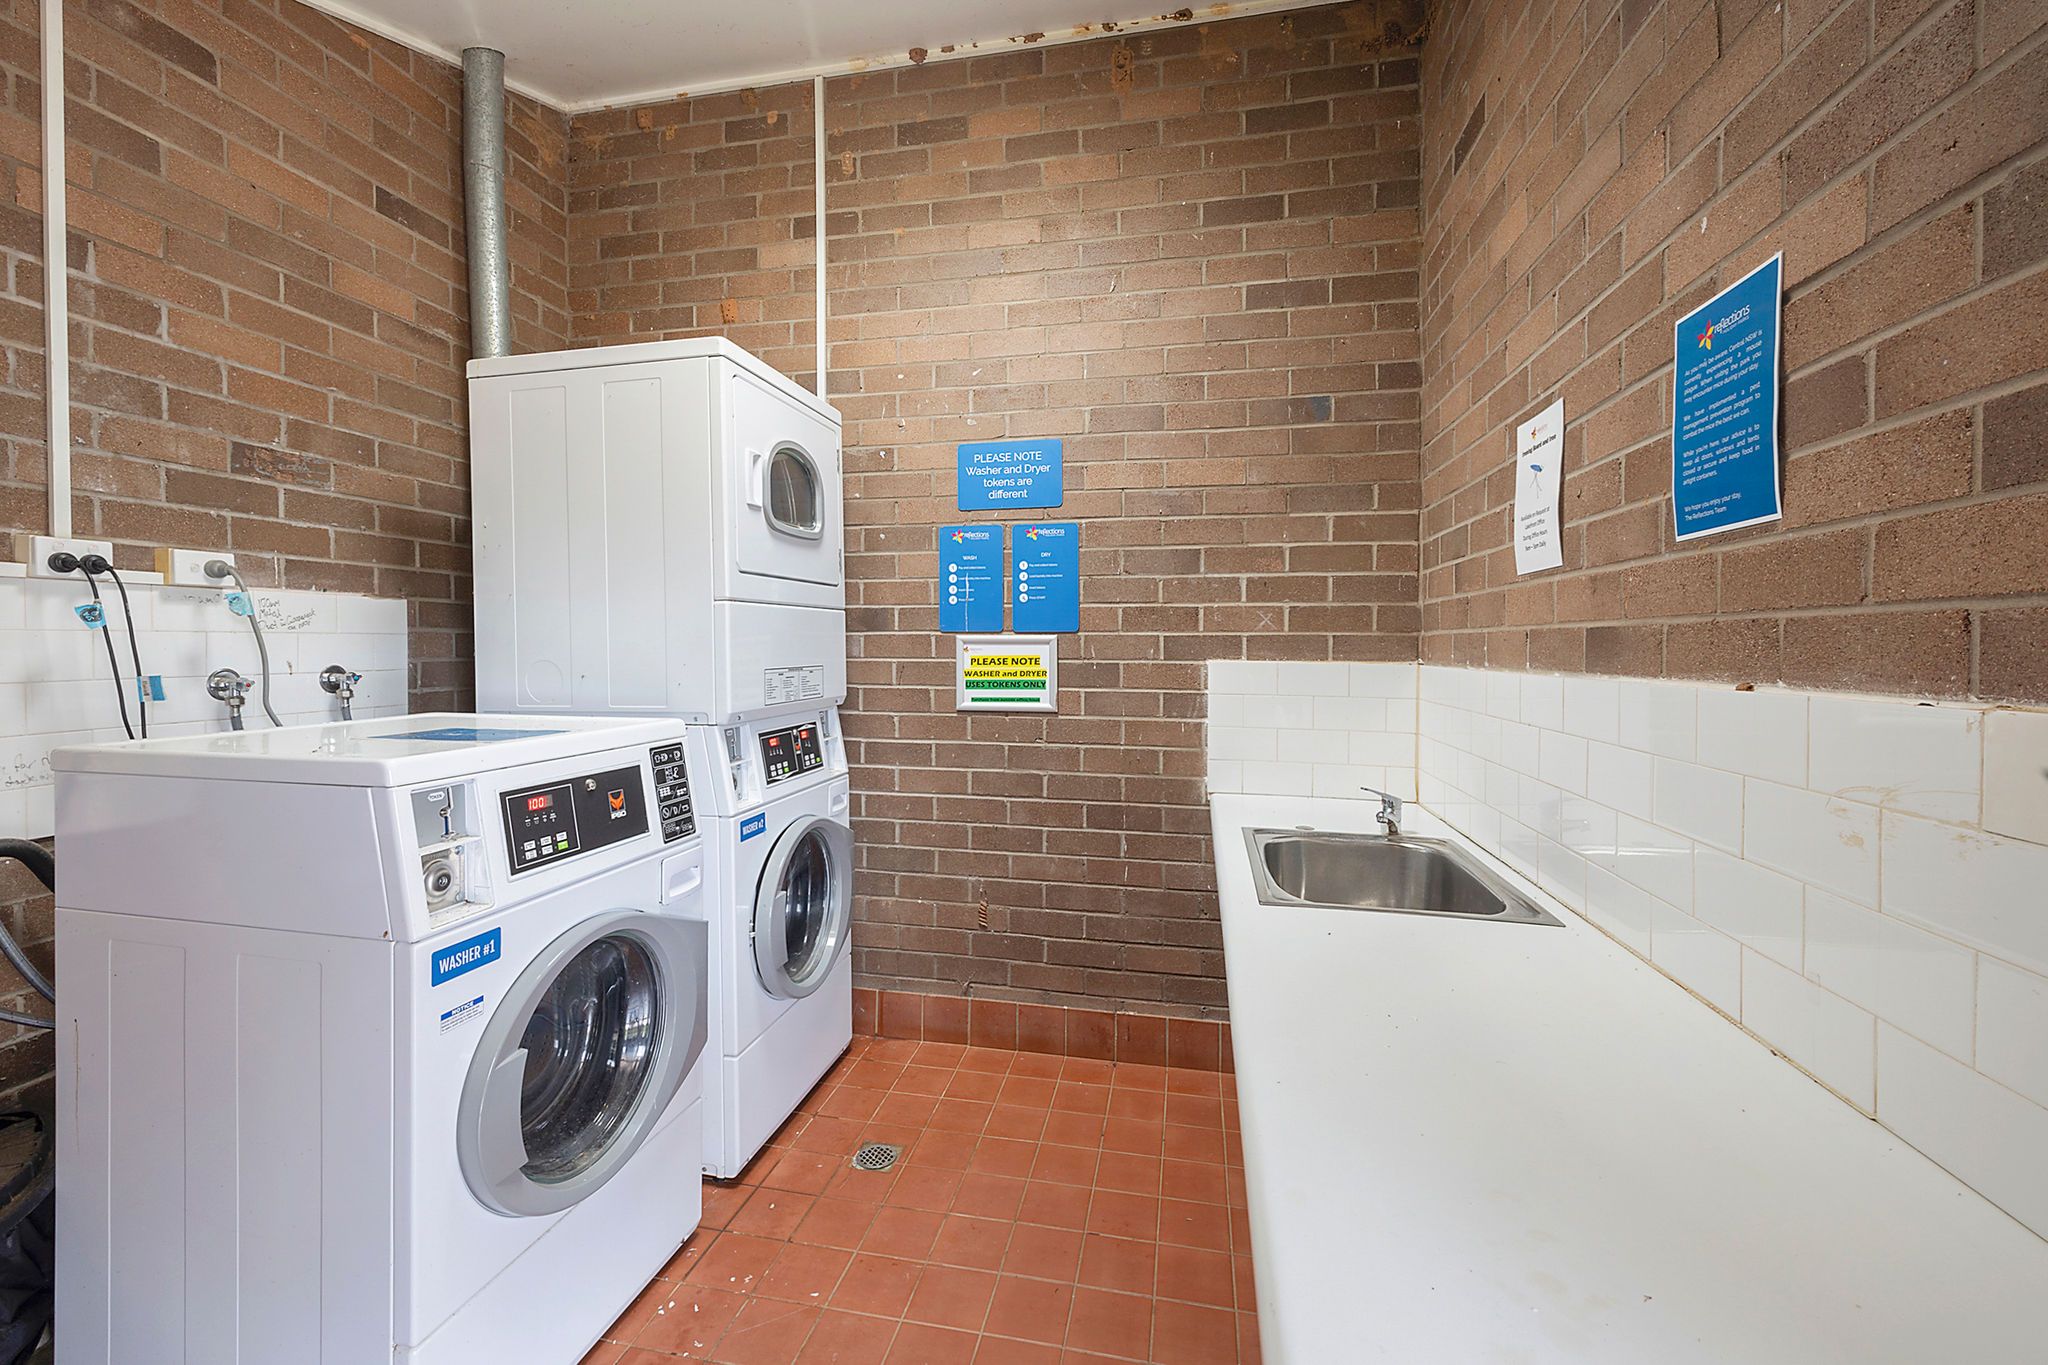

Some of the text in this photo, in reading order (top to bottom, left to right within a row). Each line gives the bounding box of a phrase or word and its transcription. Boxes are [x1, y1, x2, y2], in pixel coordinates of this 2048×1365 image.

[1714, 304, 1750, 334] reflections
[1746, 340, 1762, 352] mouse
[1731, 430, 1746, 439] advice
[974, 451, 1042, 463] PLEASE NOTE
[966, 464, 1051, 476] Washer and Dryer
[984, 478, 1015, 487] tokens
[988, 489, 1028, 499] different
[528, 797, 544, 810] 100
[439, 939, 495, 974] WASHER #1
[452, 1000, 474, 1016] NOTICE
